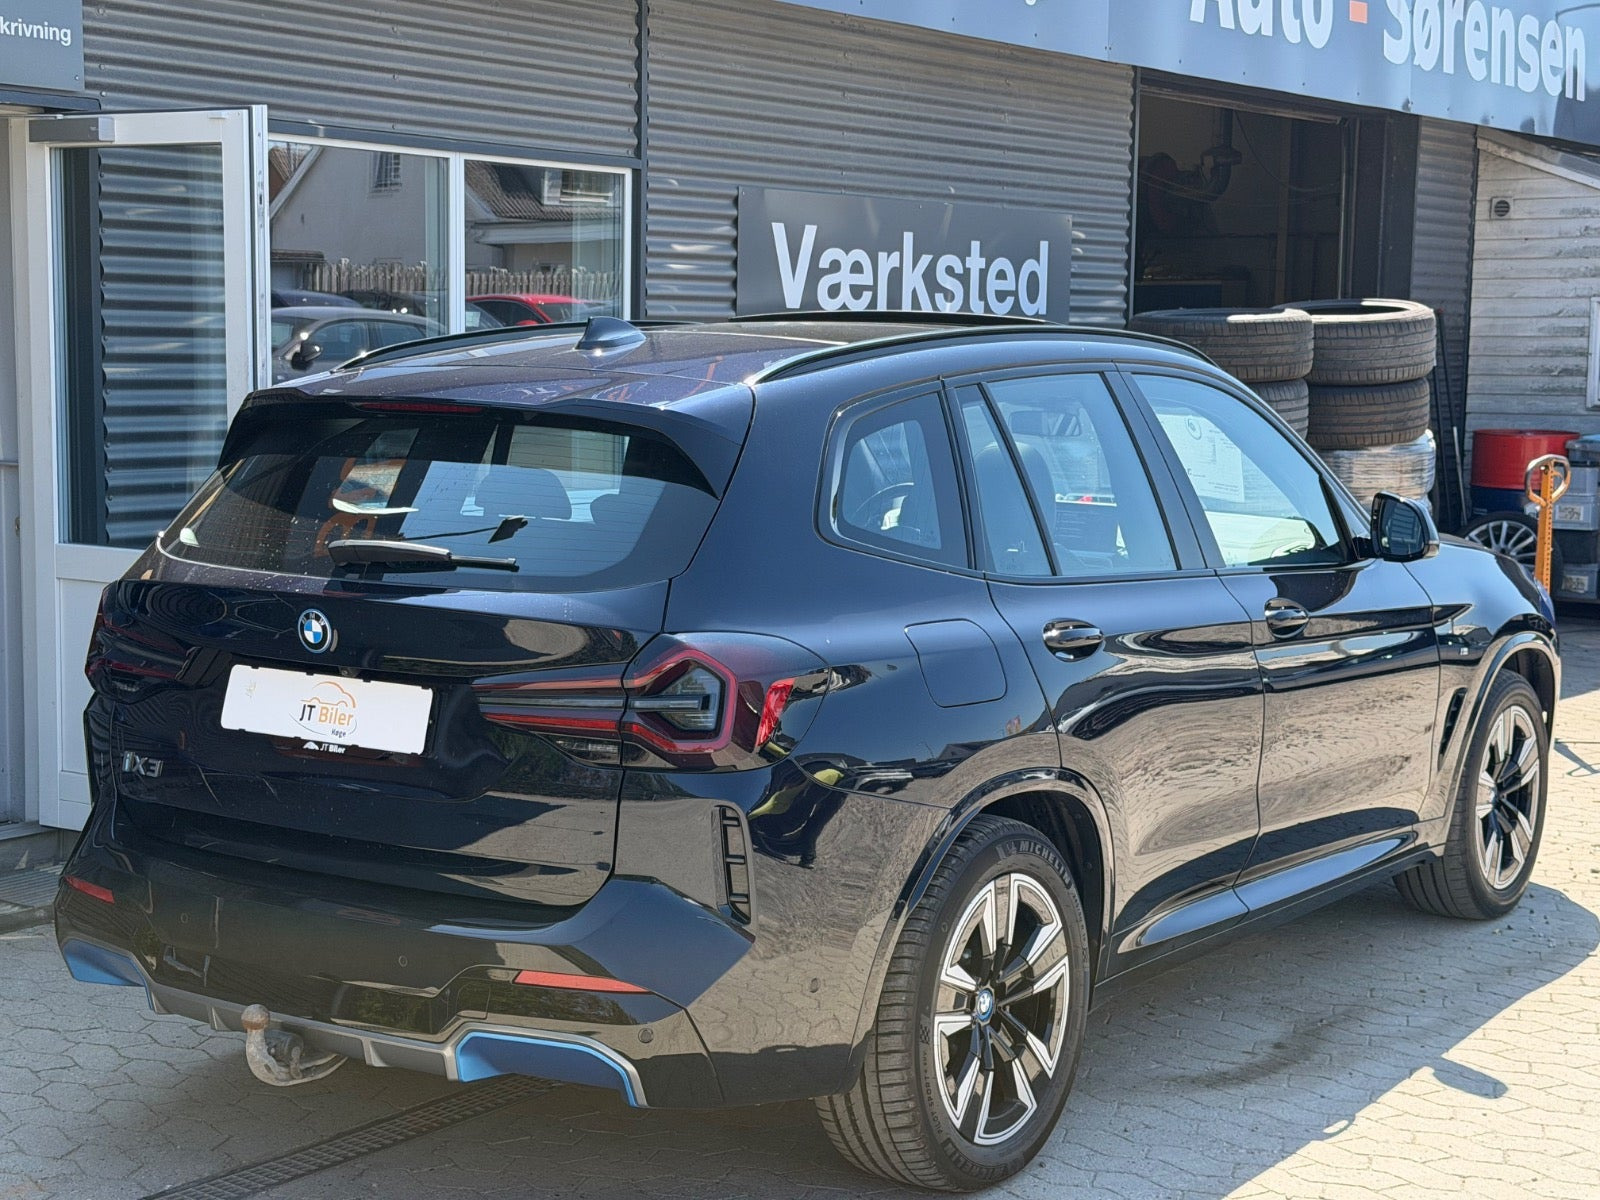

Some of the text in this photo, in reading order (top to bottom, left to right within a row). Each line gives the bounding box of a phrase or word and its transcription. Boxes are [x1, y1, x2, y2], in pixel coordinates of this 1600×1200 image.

[771, 222, 1049, 316] Værksted
[299, 704, 354, 726] JT Biler
[320, 743, 346, 754] JT Biler
[1019, 840, 1073, 887] MICHELIN
[923, 1075, 936, 1108] SPORT
